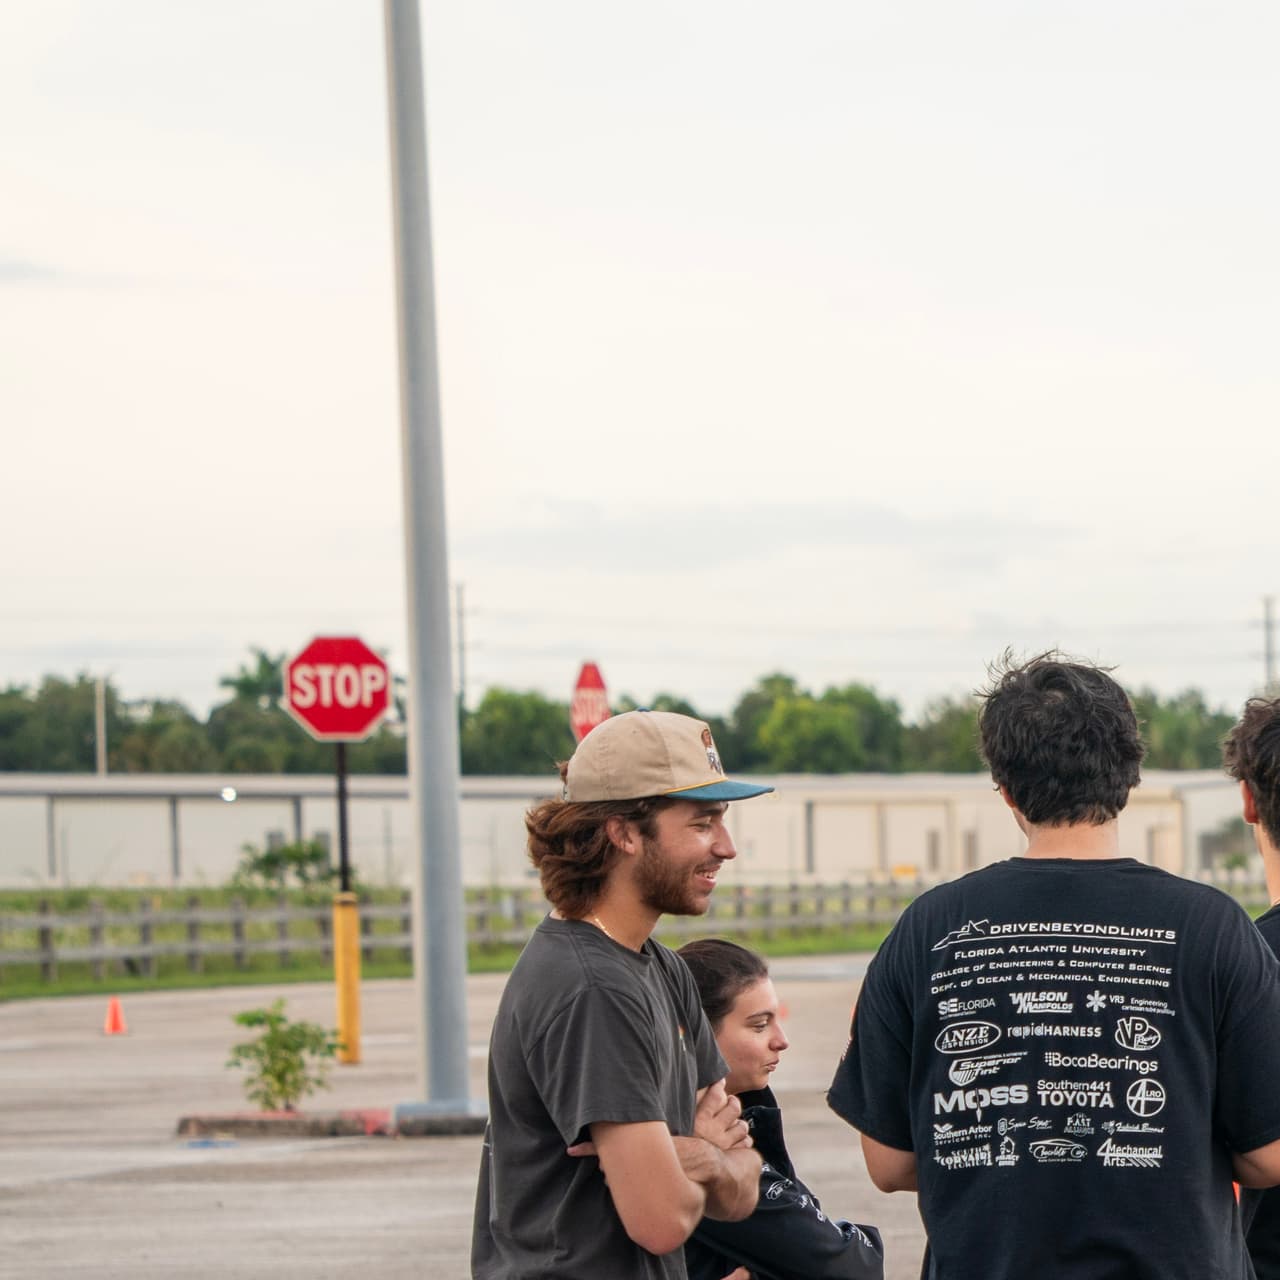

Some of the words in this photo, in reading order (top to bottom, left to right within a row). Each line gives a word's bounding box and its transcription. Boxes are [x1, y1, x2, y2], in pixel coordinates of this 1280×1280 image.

[292, 664, 387, 709] STOP
[954, 947, 1005, 960] FLORIDA
[1008, 944, 1067, 953] ATLANTIC
[1072, 945, 1146, 957] UNIVERSITY
[931, 966, 970, 981] COLLEGE
[989, 960, 1054, 970] ENGINEERING
[1070, 960, 1125, 970] COMPUTER
[1128, 963, 1172, 974] SCIENCE
[977, 975, 1012, 984] OCEAN
[1016, 973, 1024, 981] &
[1029, 973, 1094, 982] MECHANICAL
[1098, 974, 1170, 988] ENGINEERING
[1009, 991, 1068, 1005] WILSON
[1016, 1002, 1073, 1014] MANIFOLDS
[934, 1084, 1029, 1115] MOSS
[1037, 1091, 1115, 1108] TOYOTA
[968, 1125, 993, 1135] Arbor
